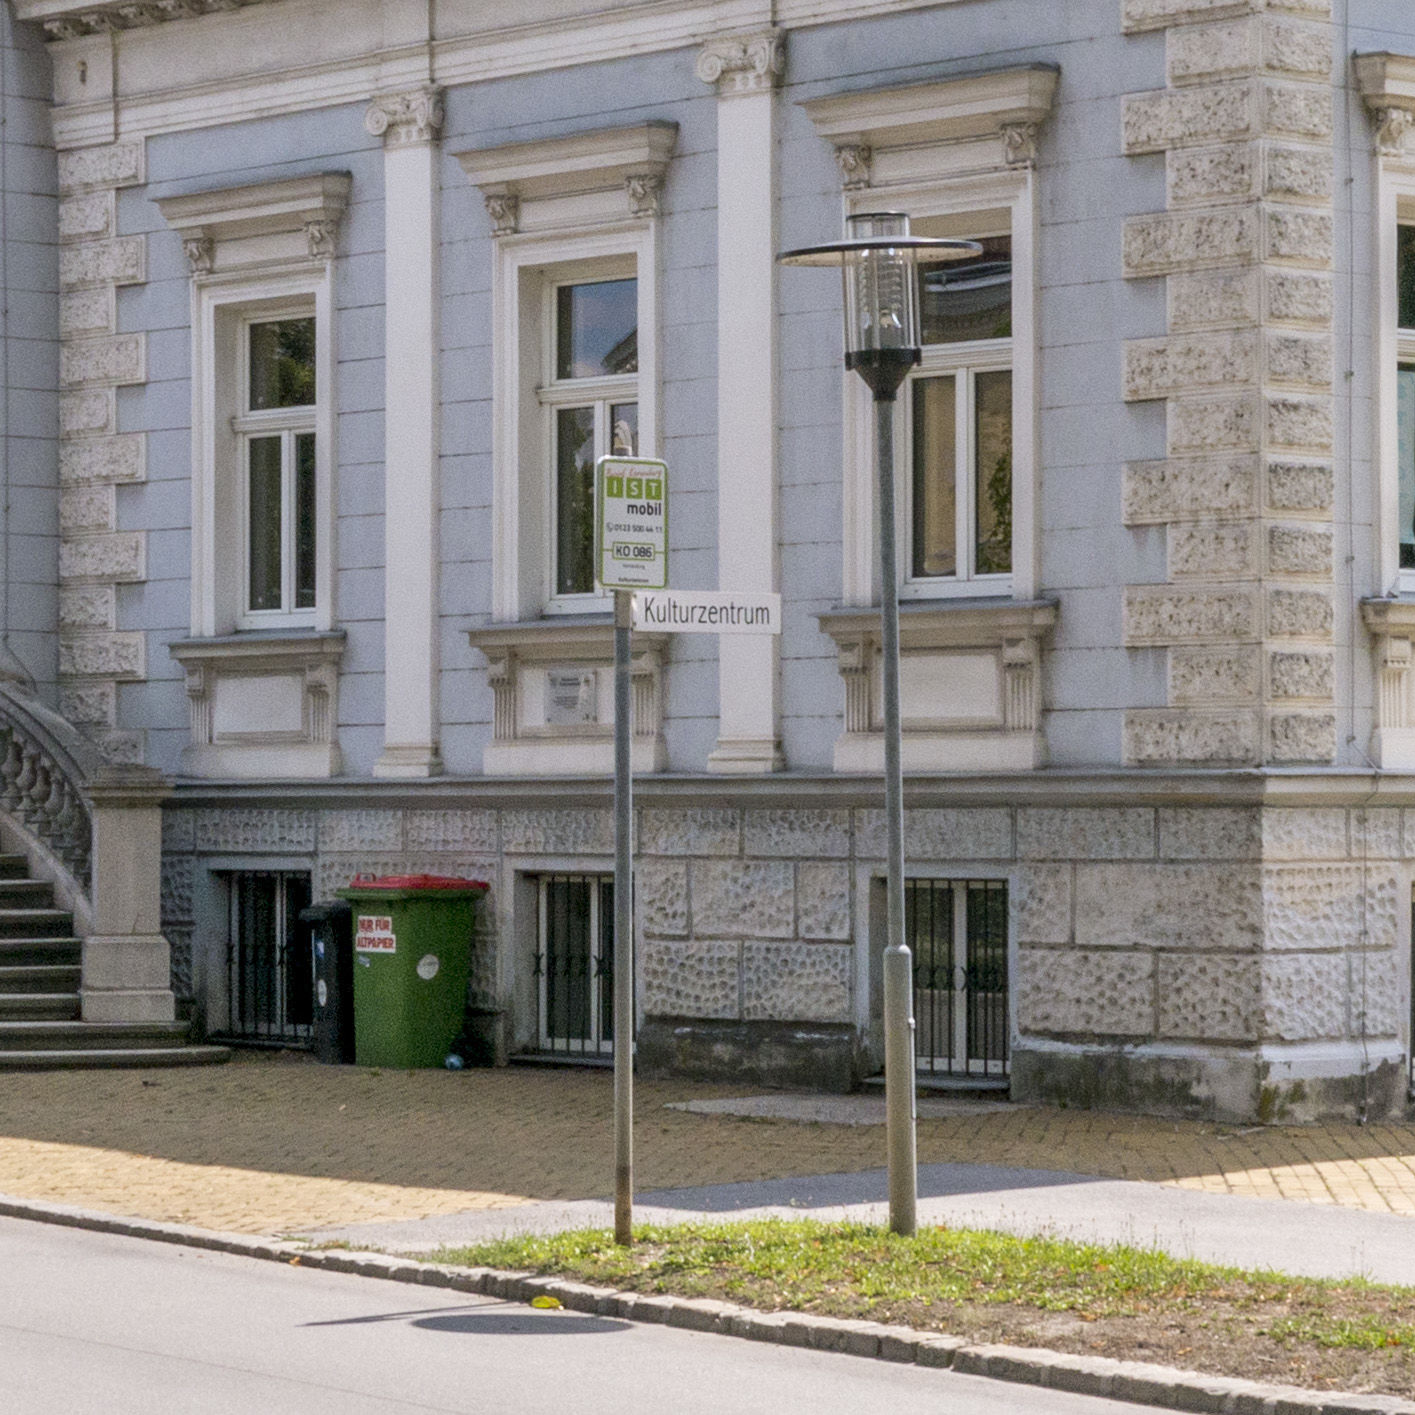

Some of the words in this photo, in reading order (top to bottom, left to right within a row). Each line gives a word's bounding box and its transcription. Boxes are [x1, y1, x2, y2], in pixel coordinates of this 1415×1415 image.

[627, 502, 662, 516] mobil
[615, 545, 630, 557] KO
[633, 546, 653, 558] 086
[644, 597, 770, 625] Kulturzentrum
